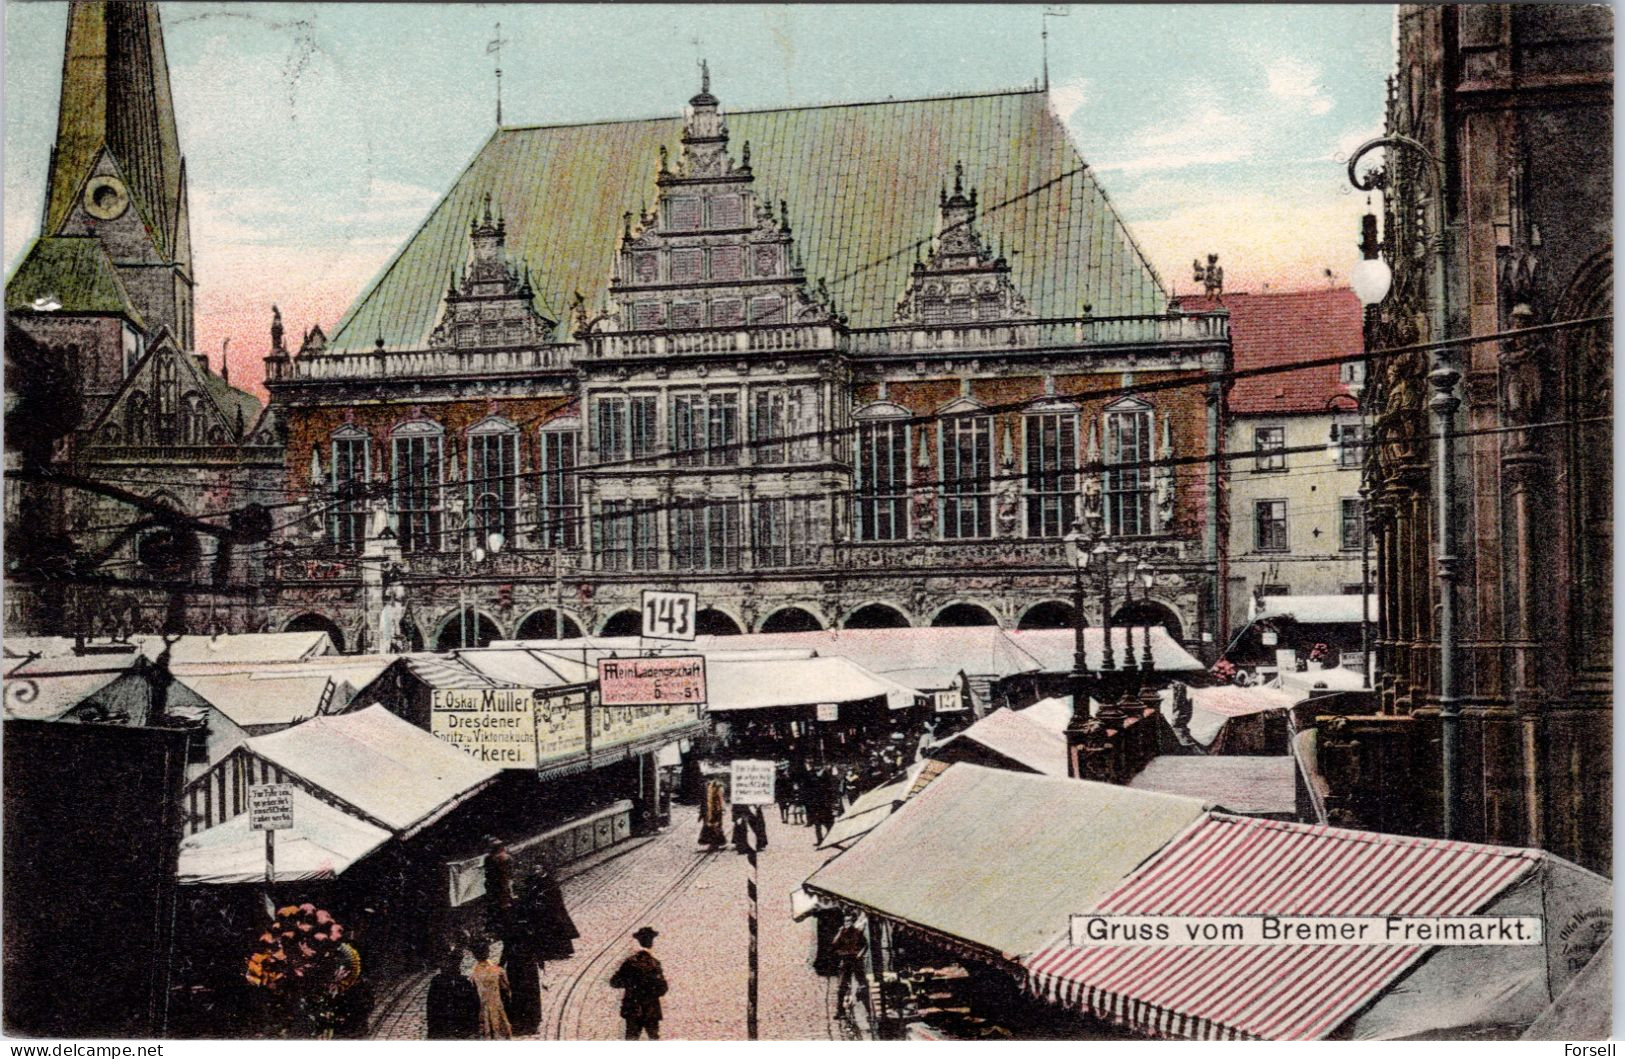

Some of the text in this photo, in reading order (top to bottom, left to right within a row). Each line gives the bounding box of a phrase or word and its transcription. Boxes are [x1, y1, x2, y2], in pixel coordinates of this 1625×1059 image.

[646, 598, 689, 634] 143
[481, 689, 529, 712] Müller
[448, 714, 521, 728] Dresdener
